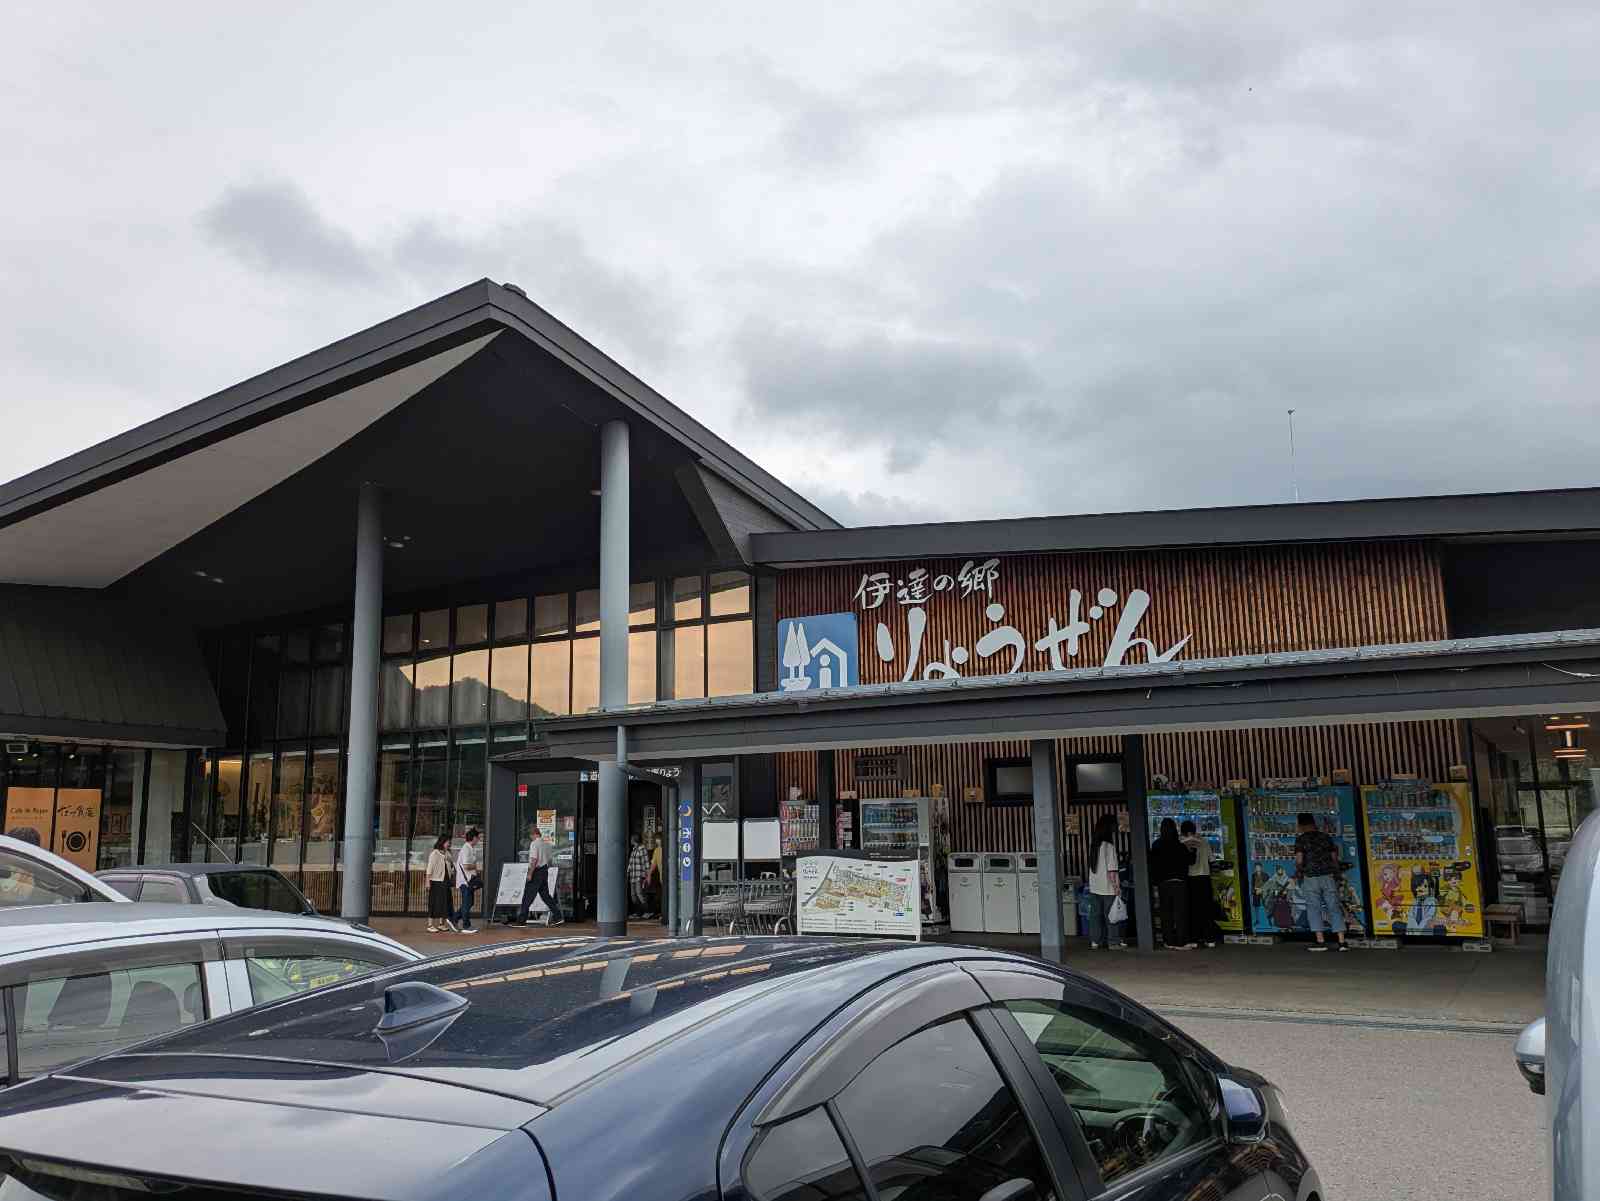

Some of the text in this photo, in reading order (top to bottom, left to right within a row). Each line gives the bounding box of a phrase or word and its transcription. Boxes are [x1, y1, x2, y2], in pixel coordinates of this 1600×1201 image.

[854, 558, 1001, 610] 伊達の郷
[876, 588, 1194, 683] りょうぜん
